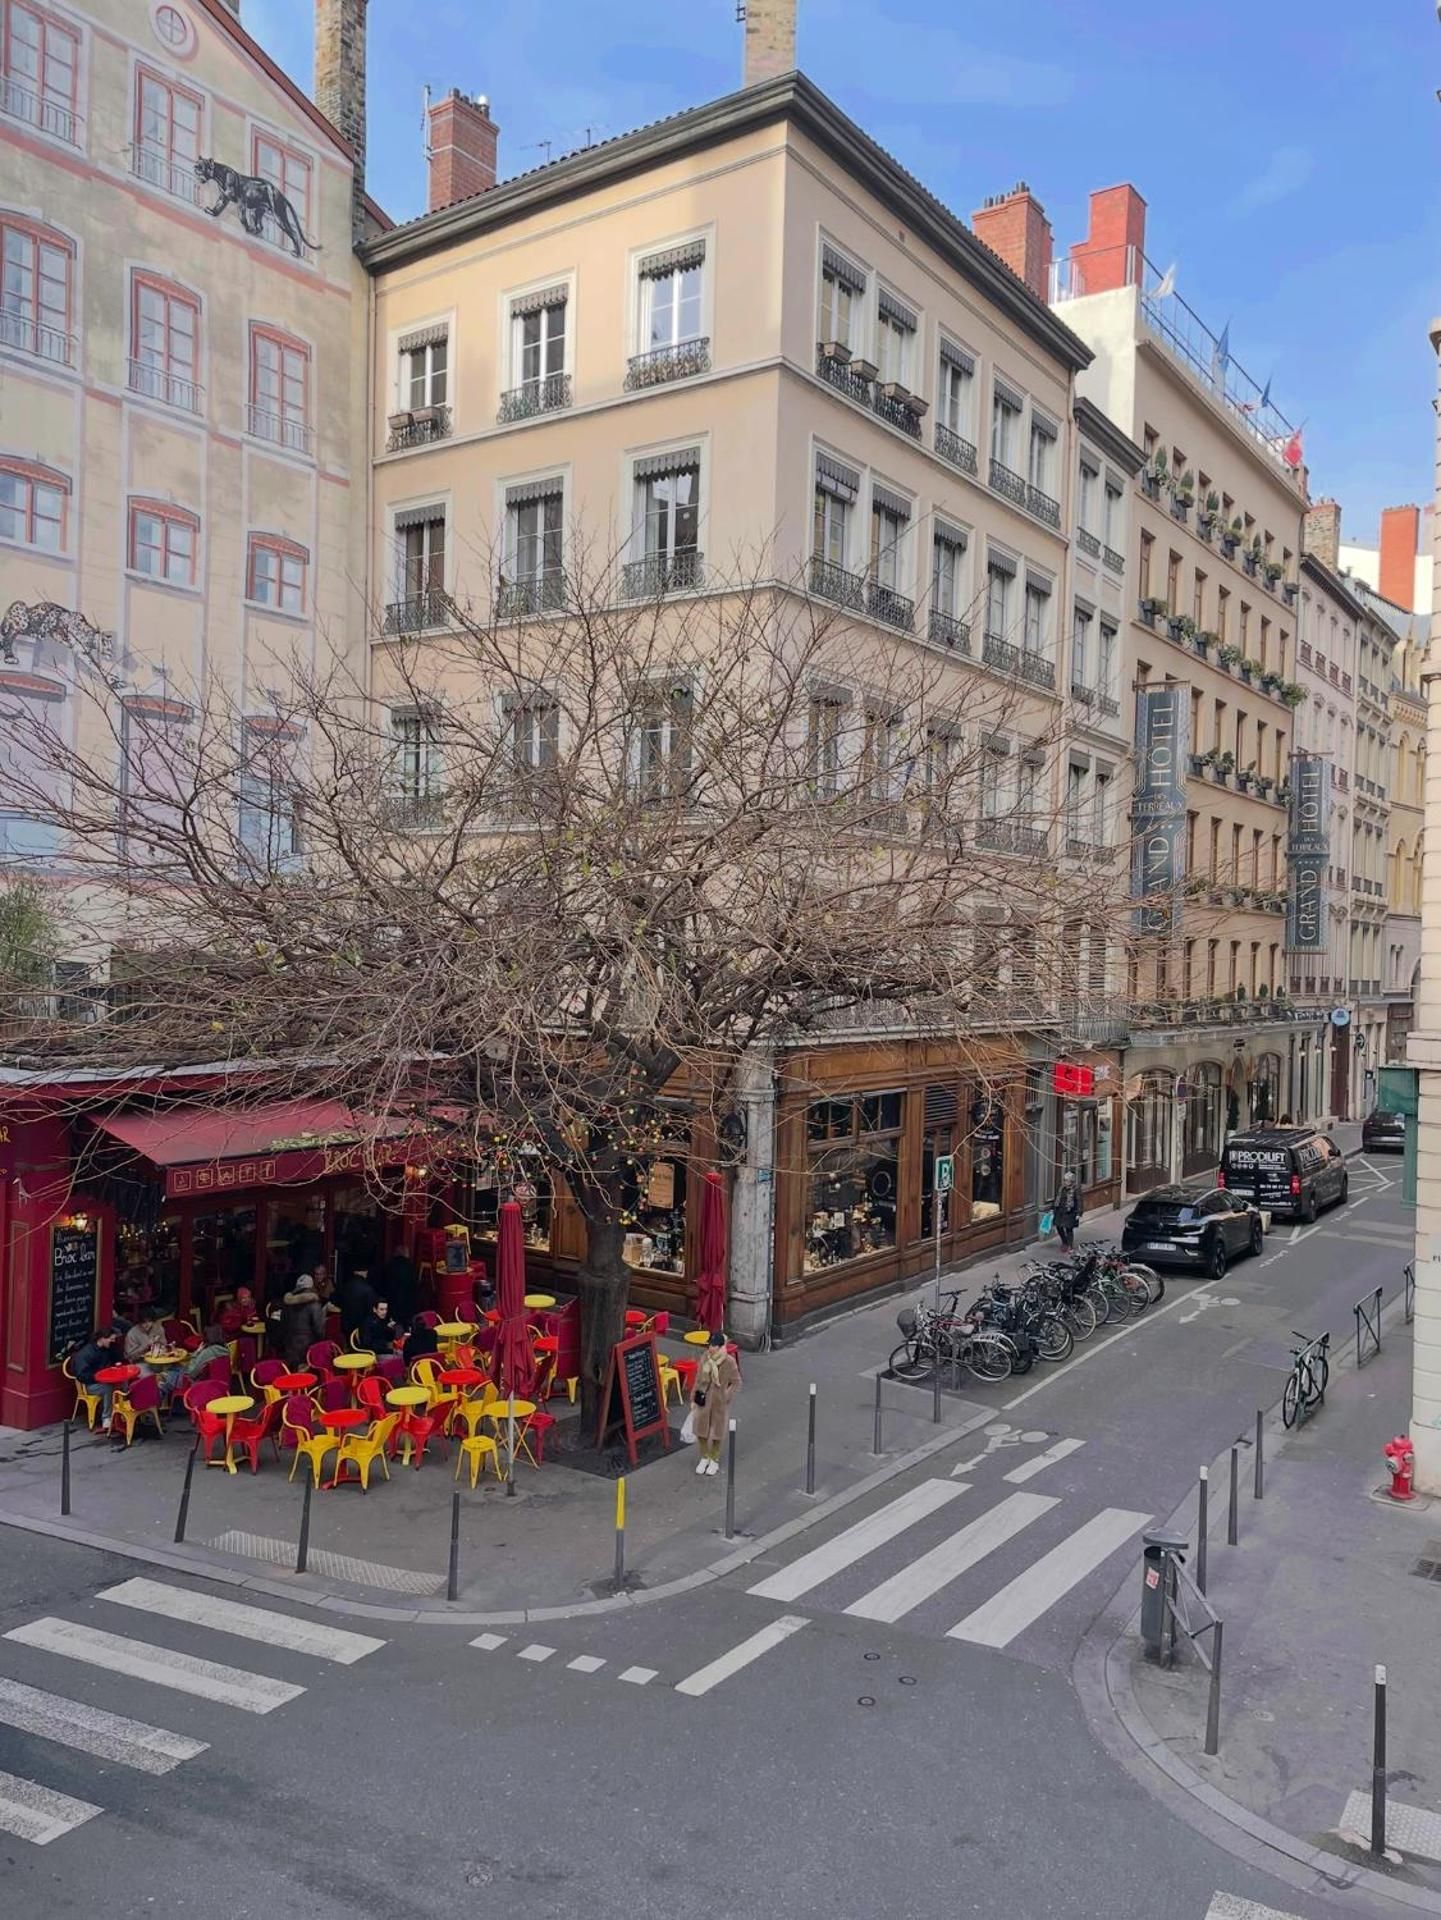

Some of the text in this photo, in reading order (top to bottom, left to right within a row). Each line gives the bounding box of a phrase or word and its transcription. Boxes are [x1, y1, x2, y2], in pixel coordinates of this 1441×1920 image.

[1148, 699, 1173, 787] HÔTEL
[1147, 837, 1169, 929] GAND
[1300, 869, 1318, 941] GRAND
[1238, 1151, 1286, 1163] PRODILIFT
